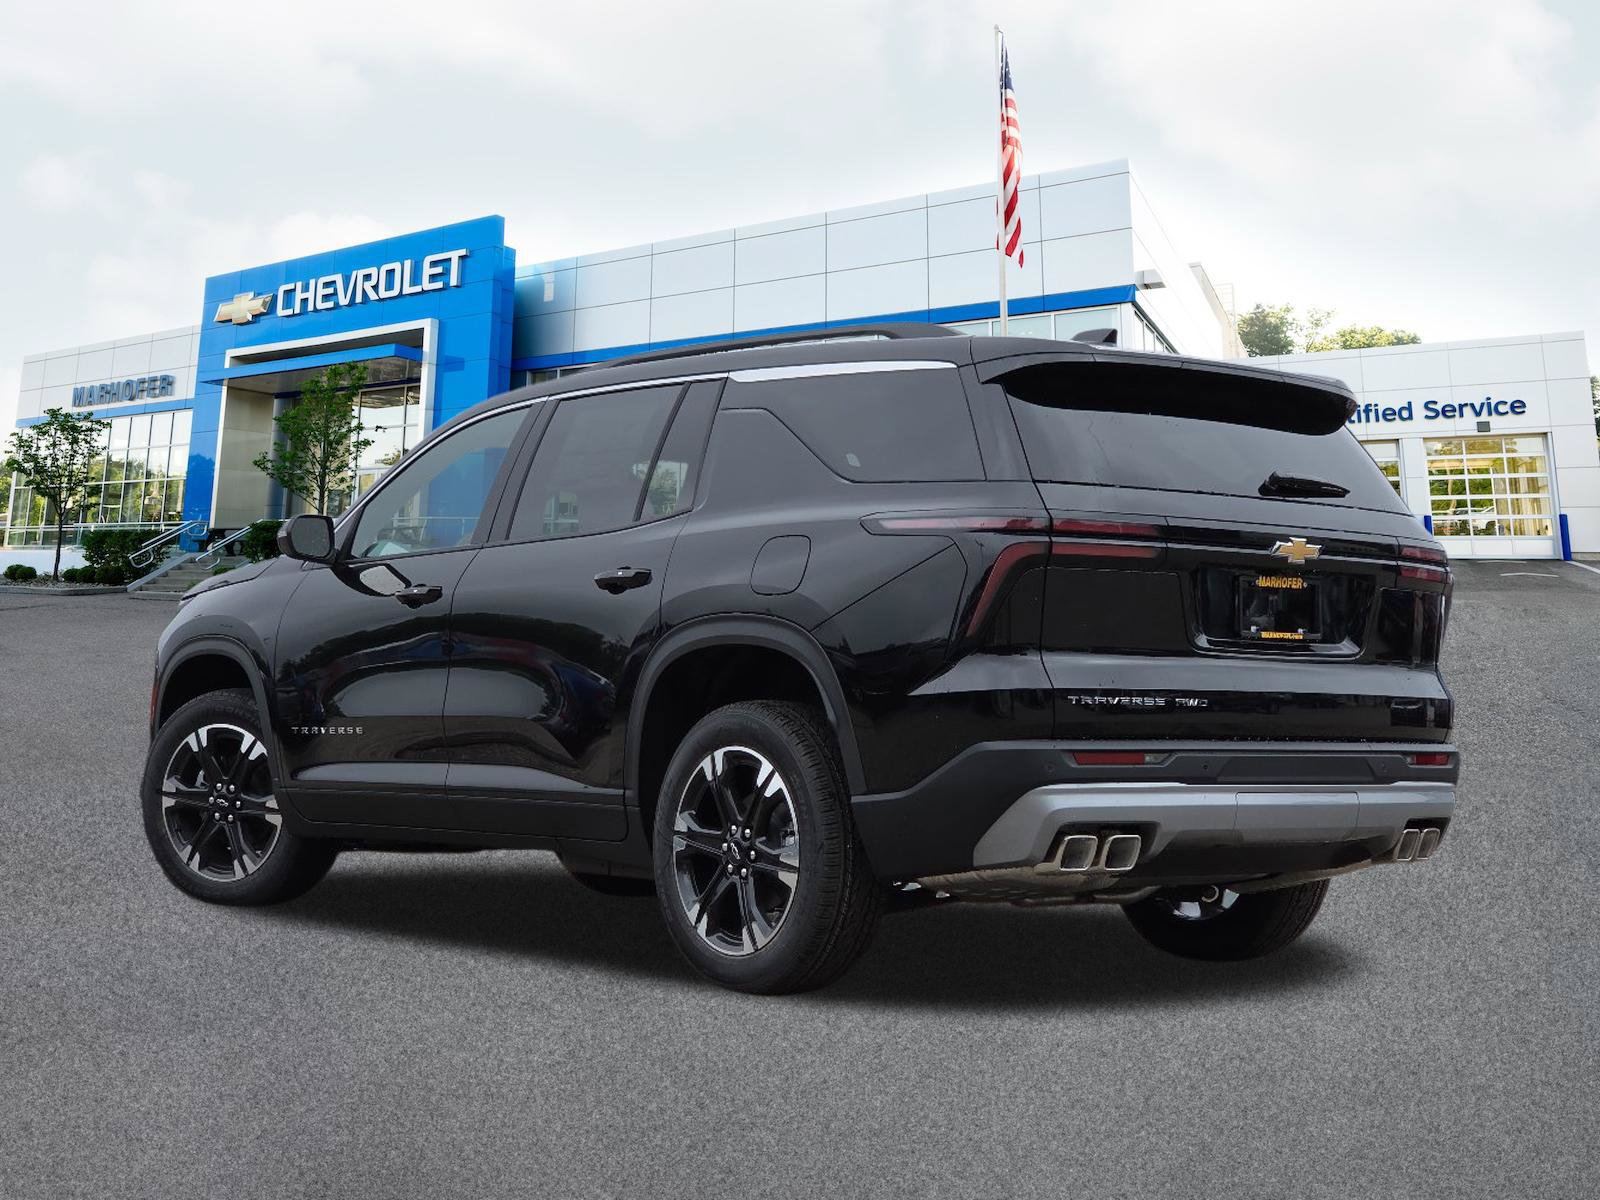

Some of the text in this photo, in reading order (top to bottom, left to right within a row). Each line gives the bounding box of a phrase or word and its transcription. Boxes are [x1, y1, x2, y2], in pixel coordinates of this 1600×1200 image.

[276, 248, 469, 318] CHEVROLET
[72, 374, 175, 408] MARHOFER
[1424, 396, 1527, 420] Service
[1258, 575, 1303, 590] MARHOFER
[1067, 695, 1166, 706] TRAVERSE
[290, 726, 363, 735] TRAVERSE
